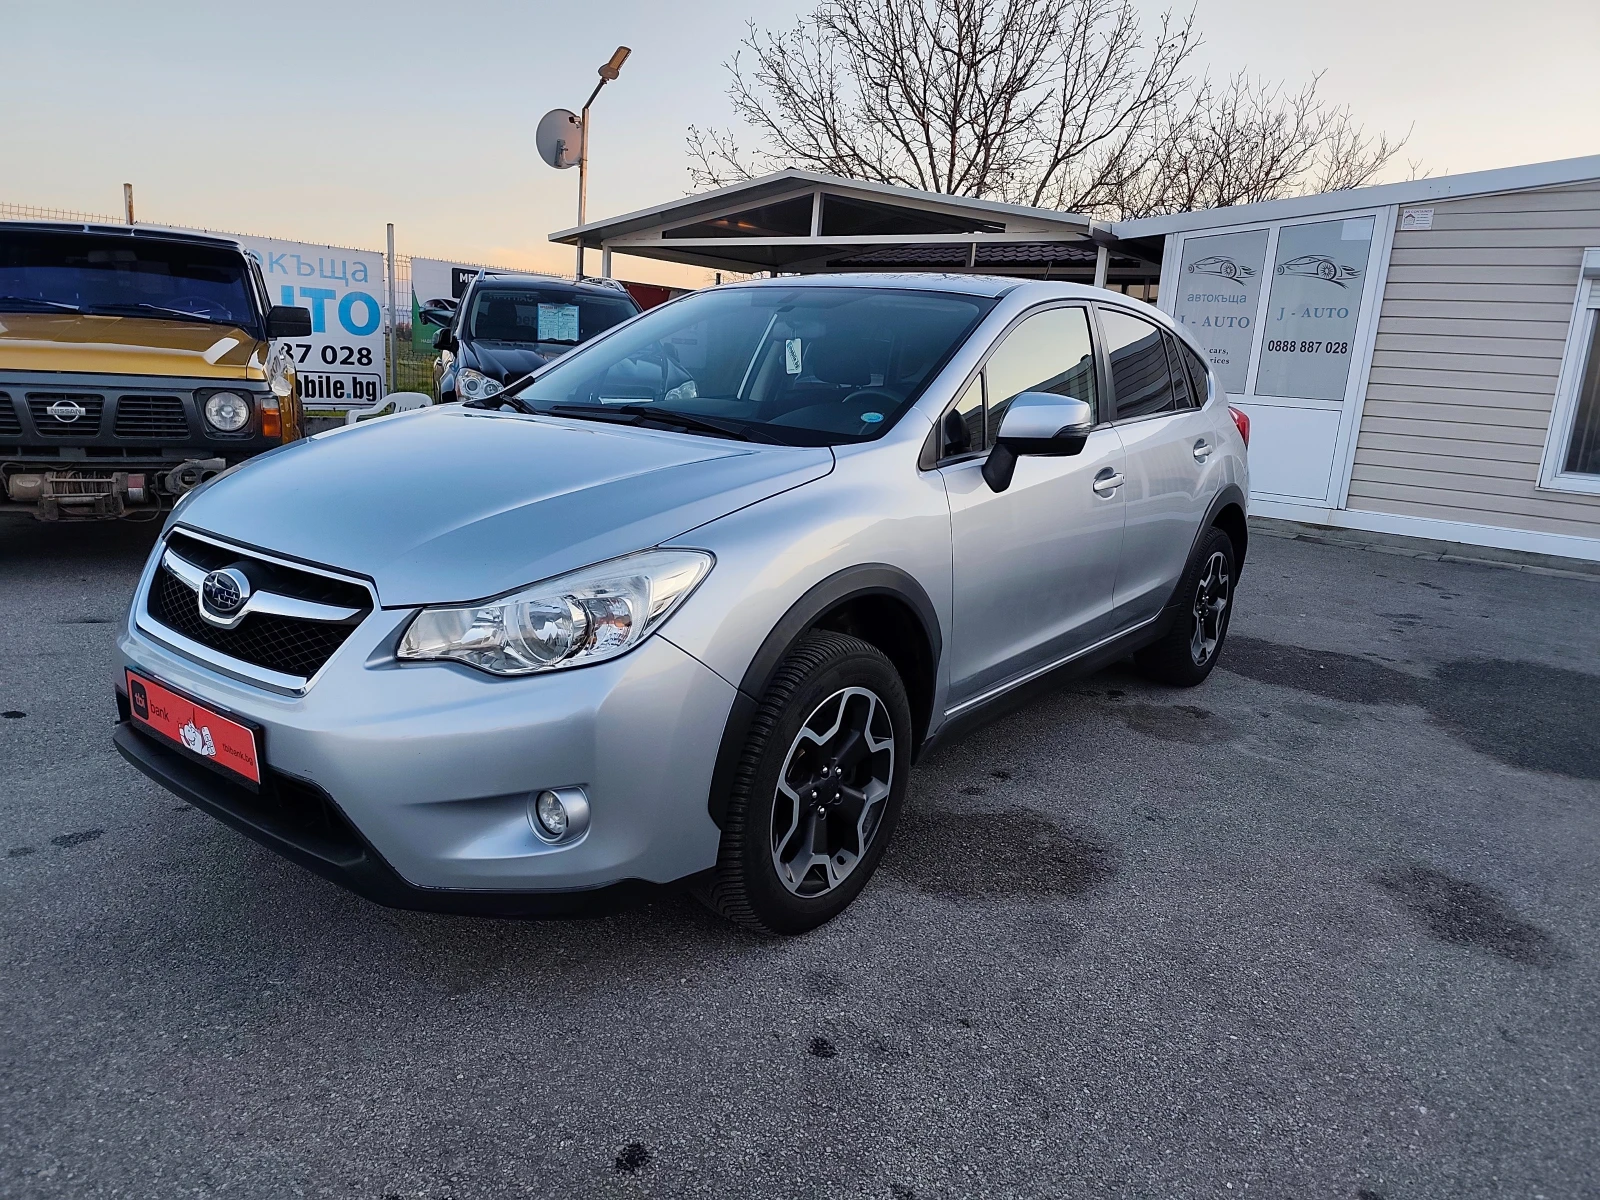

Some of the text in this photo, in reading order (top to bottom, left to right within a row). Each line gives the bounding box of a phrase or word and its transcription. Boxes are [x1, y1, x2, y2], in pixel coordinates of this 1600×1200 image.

[1187, 293, 1247, 305] автокъща
[1276, 307, 1286, 321] J
[1301, 307, 1349, 319] AUTO
[1202, 315, 1250, 329] AUTO
[1209, 347, 1229, 355] cars,
[1268, 339, 1348, 354] 0888 887 028
[320, 344, 373, 366] 028
[150, 699, 170, 722] bank
